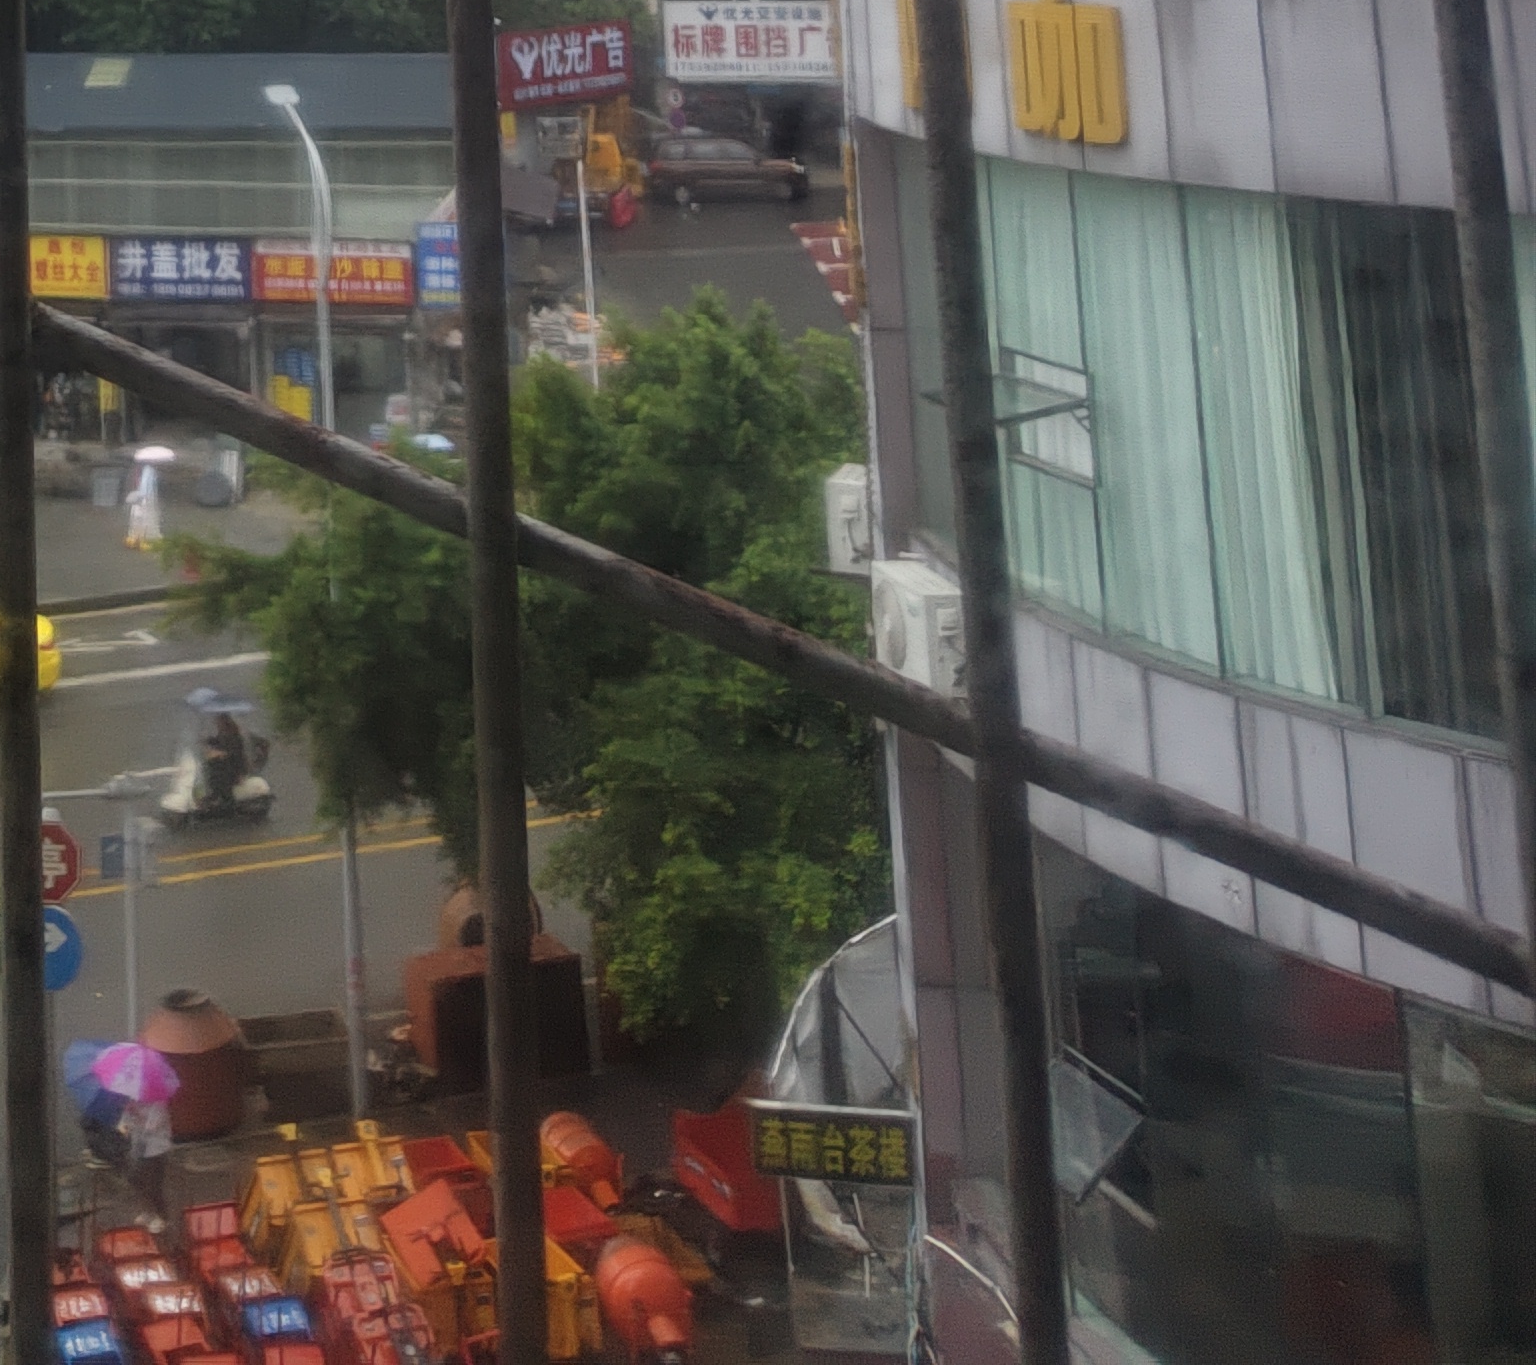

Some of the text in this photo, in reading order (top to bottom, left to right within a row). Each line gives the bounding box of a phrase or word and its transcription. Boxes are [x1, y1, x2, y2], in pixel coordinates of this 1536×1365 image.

[542, 26, 624, 78] 优光广告
[117, 238, 243, 281] 井盖批发
